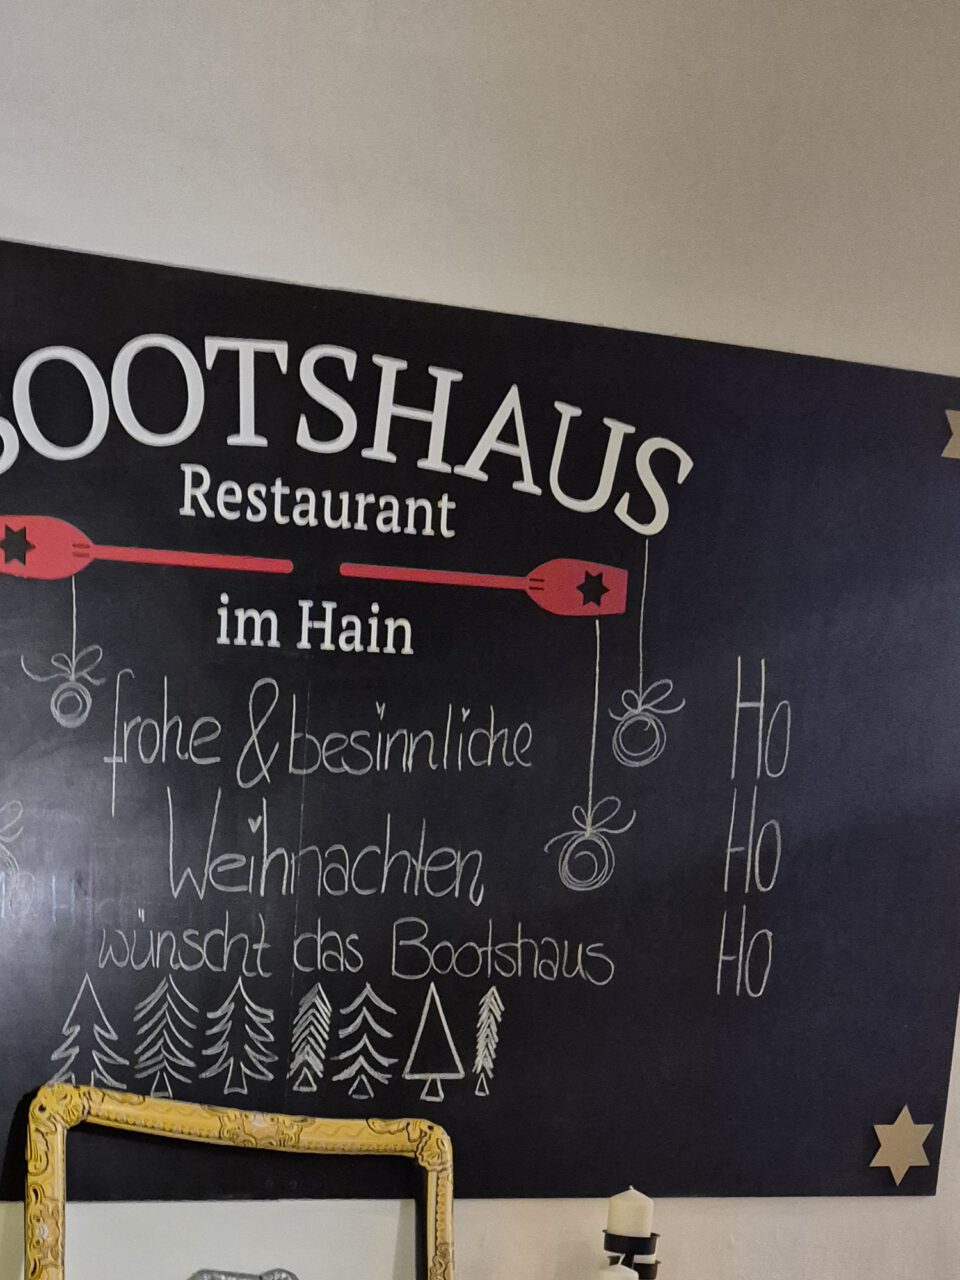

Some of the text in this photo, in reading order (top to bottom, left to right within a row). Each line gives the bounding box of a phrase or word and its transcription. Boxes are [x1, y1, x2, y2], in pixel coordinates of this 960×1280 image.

[179, 463, 456, 538] Restaurant
[215, 592, 414, 655] im Hain
[103, 668, 222, 817] frohe
[167, 786, 485, 907] Weihnachten
[98, 908, 616, 986] wünscht das Bootshaus
